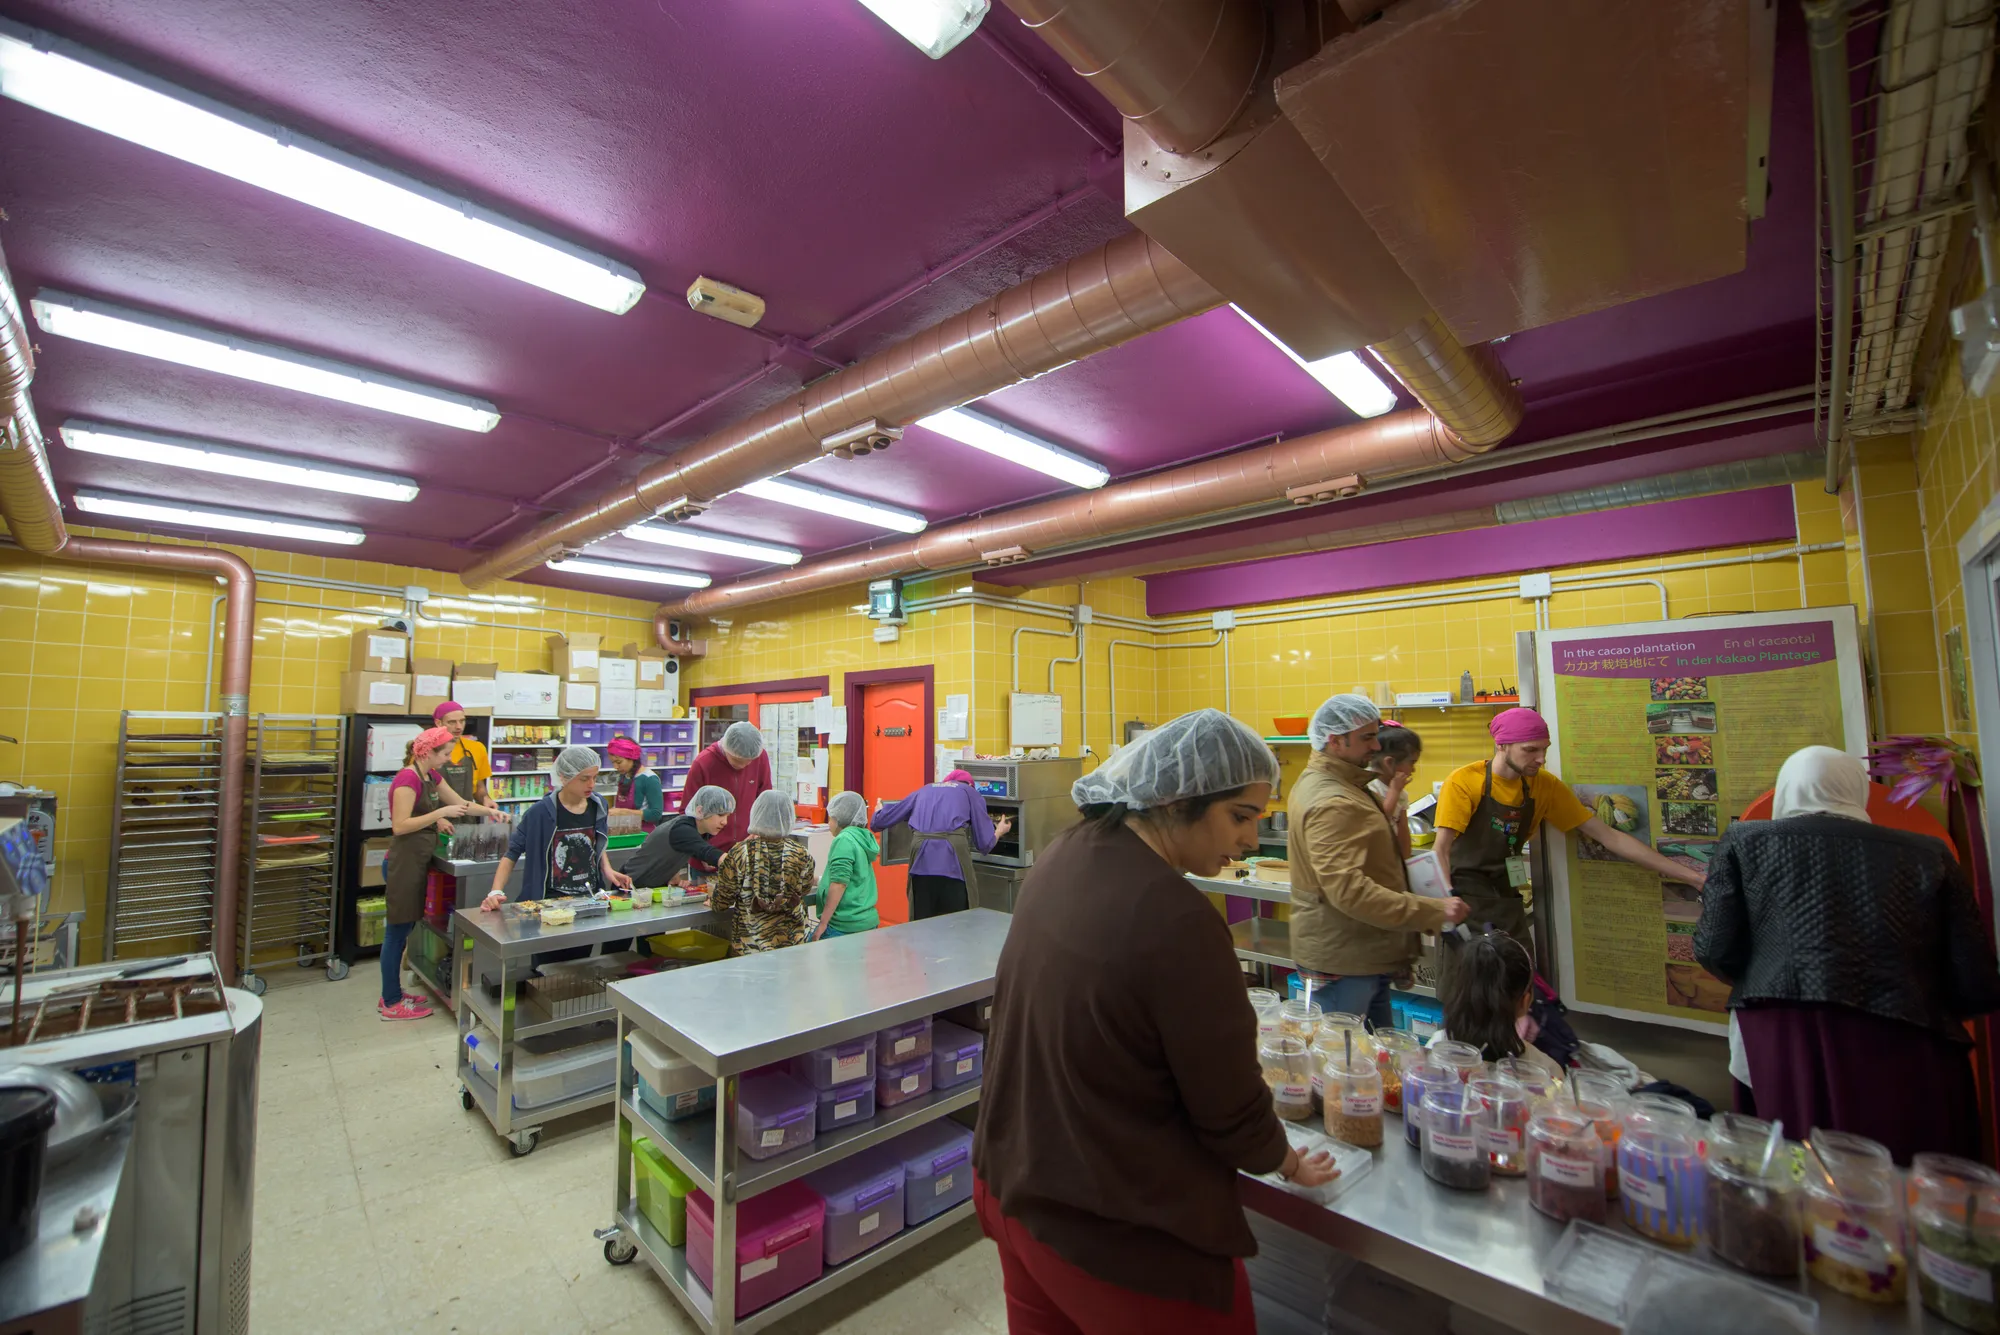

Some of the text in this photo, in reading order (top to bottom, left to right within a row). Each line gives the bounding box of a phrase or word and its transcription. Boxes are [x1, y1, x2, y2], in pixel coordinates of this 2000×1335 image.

[1724, 633, 1816, 649] En el cacaotal
[1563, 641, 1696, 658] In the cacao plantation
[1564, 656, 1670, 672] カカオ栽培地にて
[1676, 650, 1821, 666] In der Kakao Plantage
